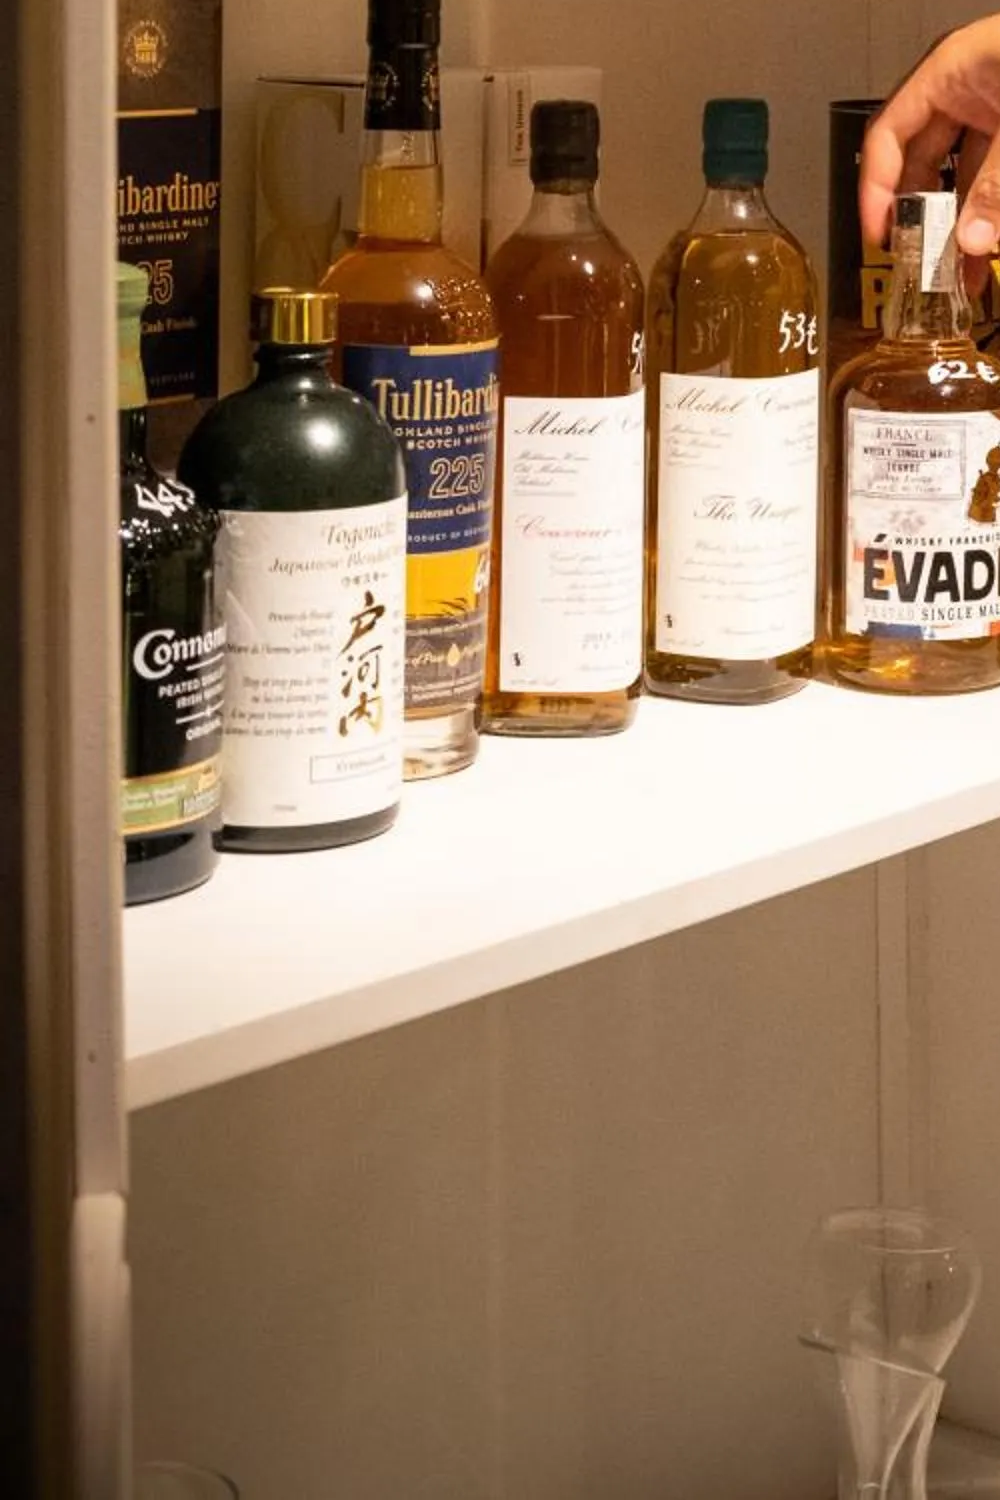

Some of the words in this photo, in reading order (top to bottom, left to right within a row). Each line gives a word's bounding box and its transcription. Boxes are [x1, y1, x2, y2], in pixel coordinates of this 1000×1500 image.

[118, 171, 216, 217] ibardine
[394, 424, 454, 438] GHLAND
[428, 452, 486, 499] 225
[693, 494, 736, 521] The
[894, 535, 943, 547] WHISKY
[921, 606, 973, 622] SINGLE
[158, 678, 201, 698] PEATED
